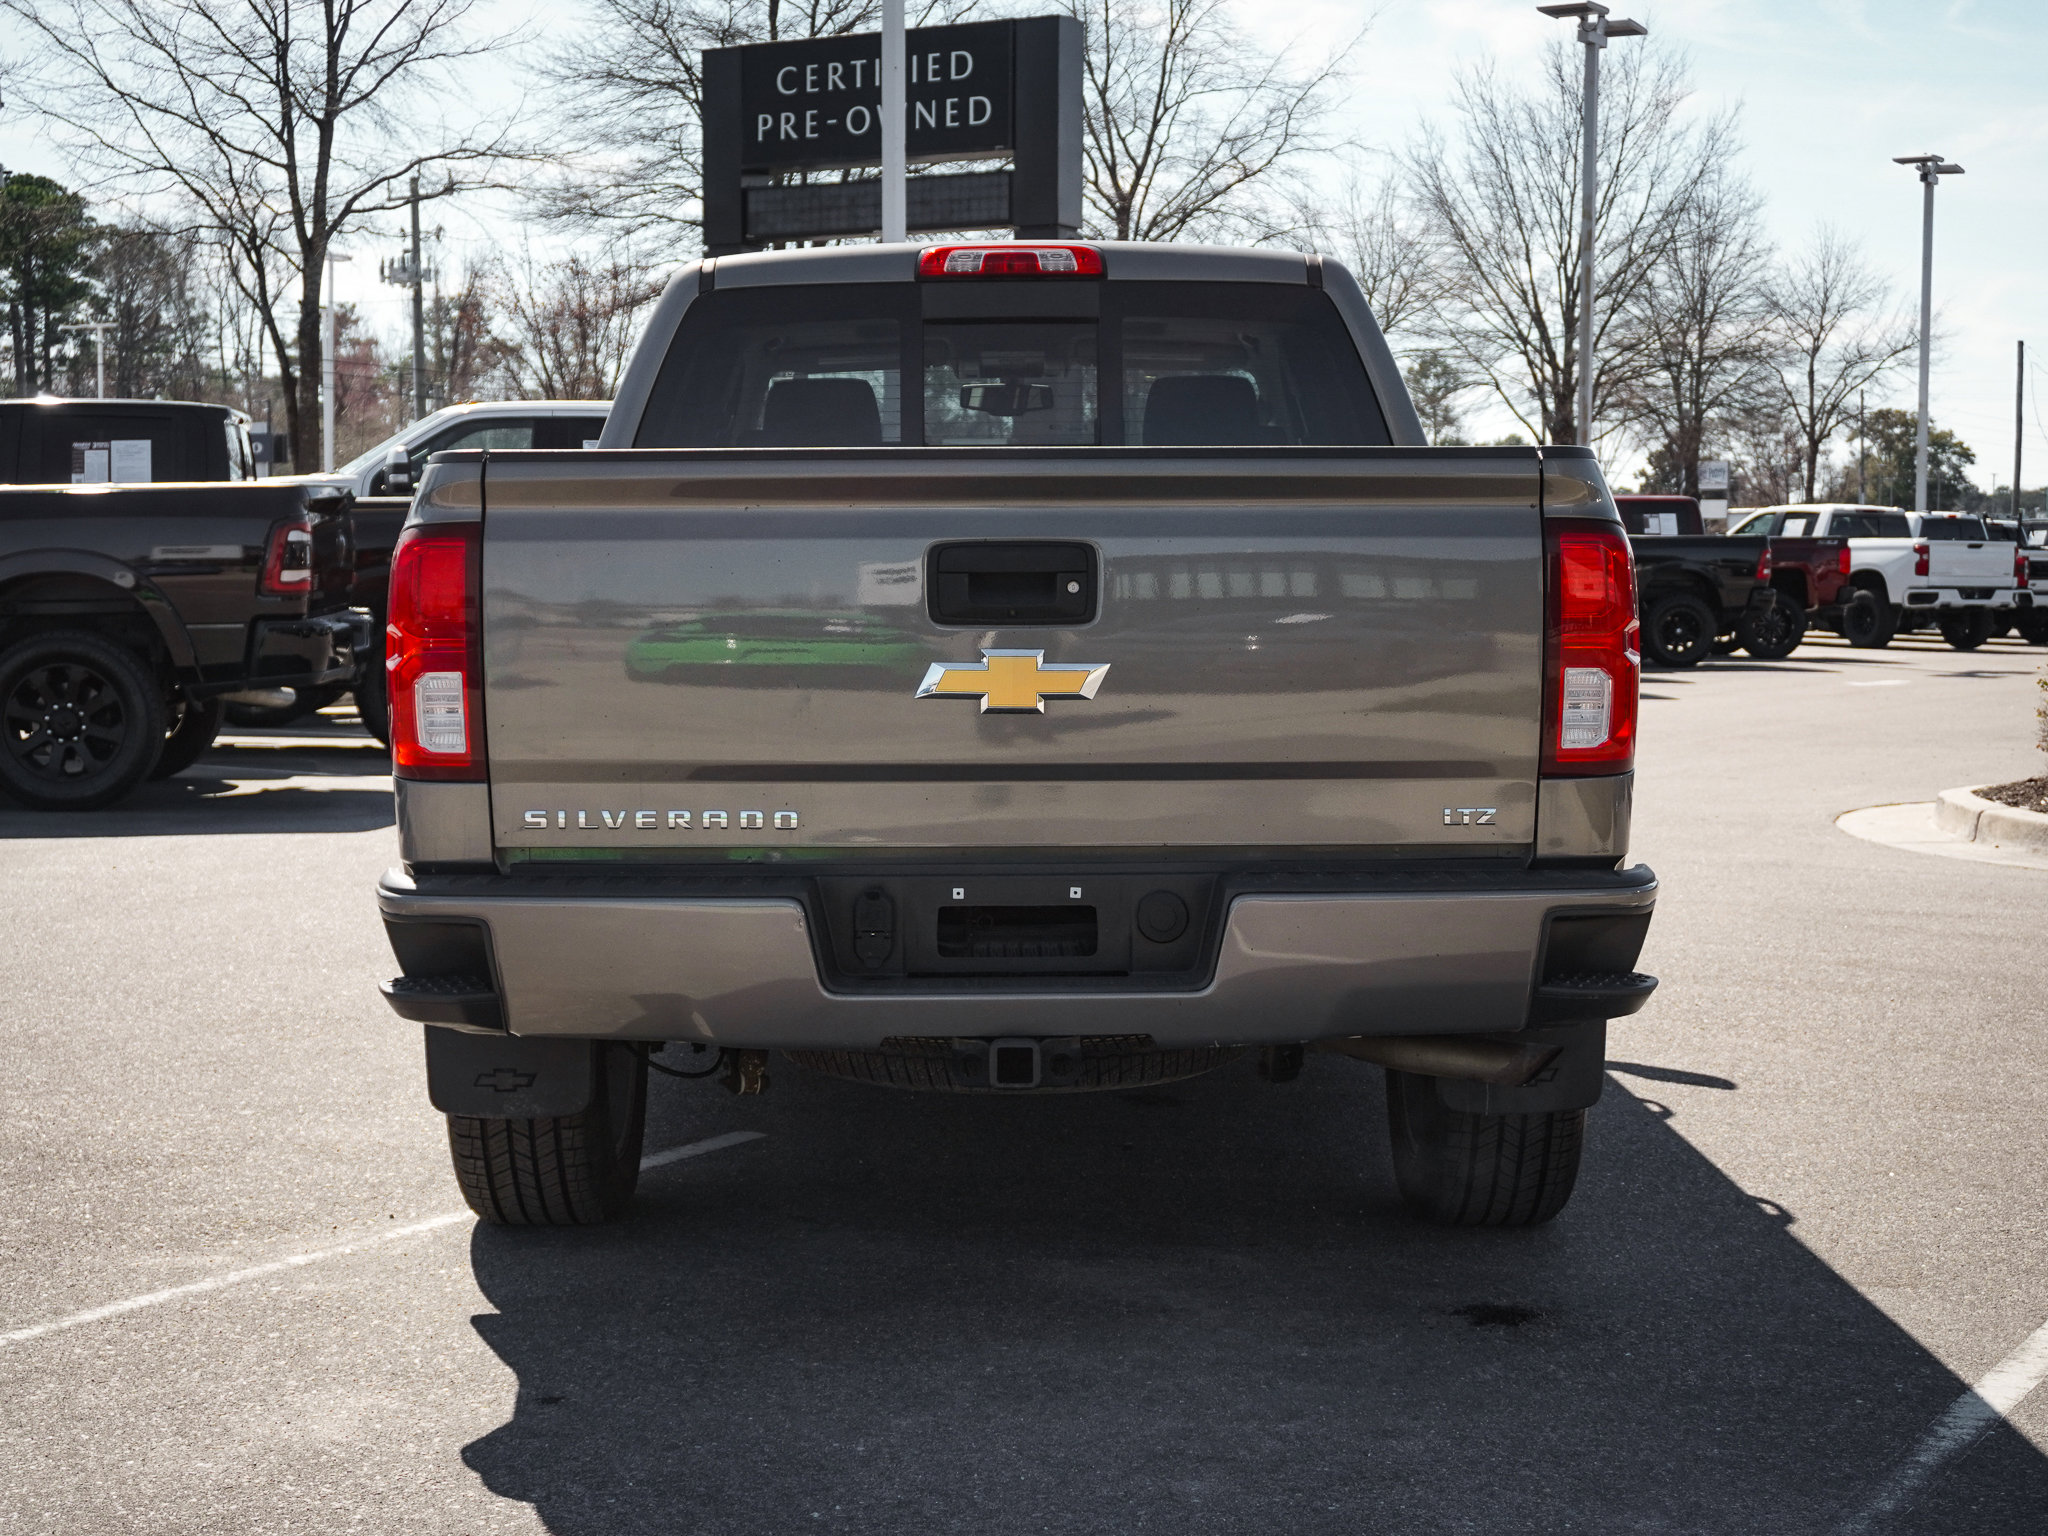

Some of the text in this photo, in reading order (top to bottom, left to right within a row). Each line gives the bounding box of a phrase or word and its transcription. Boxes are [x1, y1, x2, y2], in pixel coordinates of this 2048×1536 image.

[776, 50, 974, 95] CERTIIED
[757, 95, 992, 141] PRE-ONED
[523, 809, 799, 831] SILVERADO
[1443, 807, 1497, 826] LTZ
